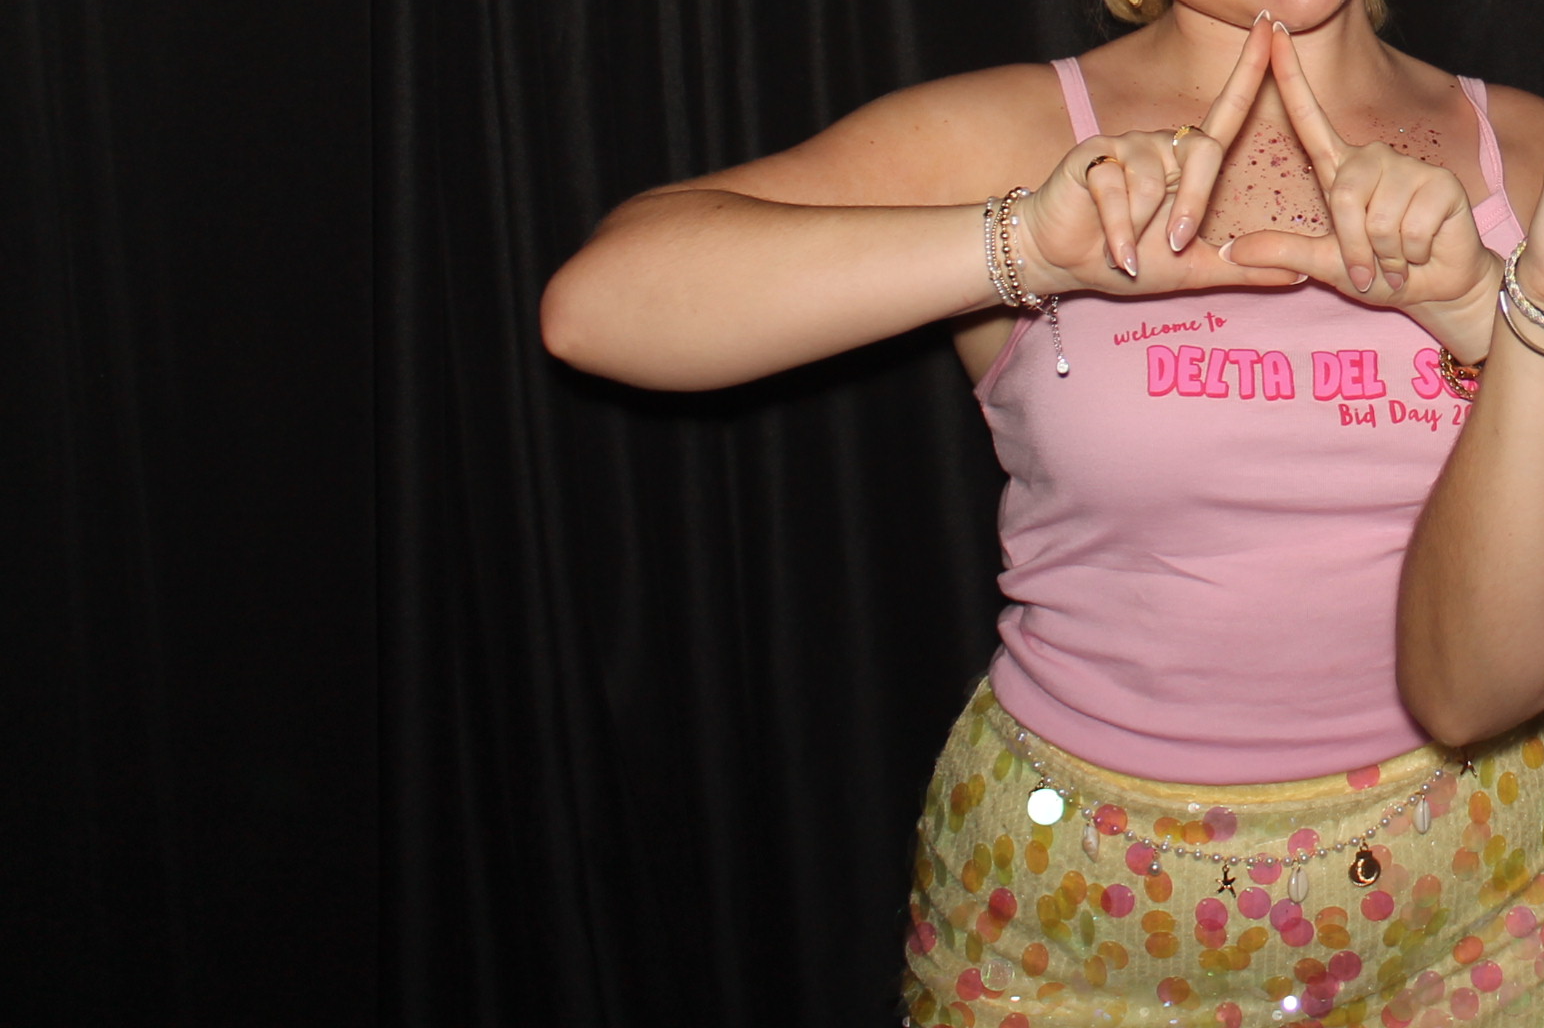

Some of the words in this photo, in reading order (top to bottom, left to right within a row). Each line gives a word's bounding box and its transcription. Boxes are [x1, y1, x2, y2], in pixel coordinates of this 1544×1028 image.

[1113, 320, 1202, 346] welcome
[1203, 311, 1228, 333] to
[1147, 345, 1295, 401] DELTA
[1311, 349, 1386, 401] DEL
[1338, 403, 1376, 429] Bid
[1389, 400, 1443, 432] Day
